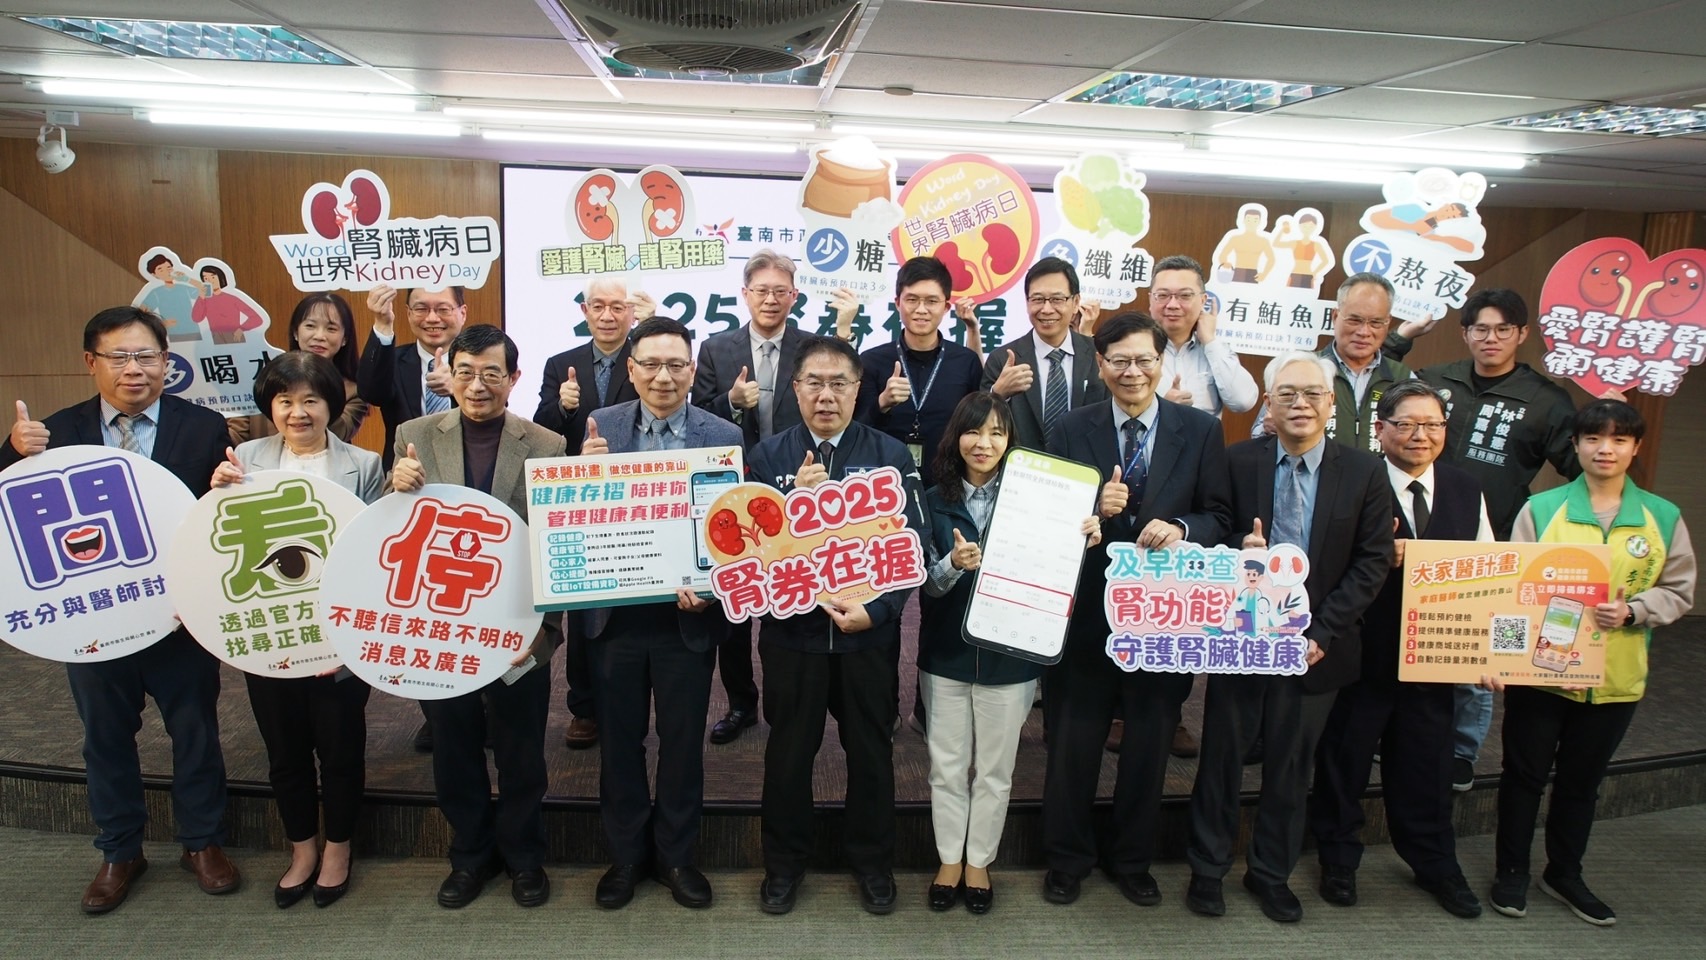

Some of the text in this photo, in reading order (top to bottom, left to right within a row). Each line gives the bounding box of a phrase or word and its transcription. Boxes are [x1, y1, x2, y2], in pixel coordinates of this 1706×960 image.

[925, 190, 1019, 243] 腎臟病日
[284, 241, 347, 258] Word
[348, 225, 492, 261] 腎臟病日
[737, 225, 805, 243] 臺南市
[296, 255, 355, 283] 世界
[355, 261, 481, 284] Kidney Day
[541, 243, 627, 276] 愛護腎臟
[531, 463, 602, 481] 大家醫計畫
[531, 482, 625, 506] 健康存摺
[630, 481, 687, 499] 陪伴你
[788, 474, 898, 534] 2025
[547, 502, 689, 528] 管理健康真便利
[383, 501, 508, 612] 停
[457, 550, 471, 558] STOP
[1412, 552, 1517, 584] 大家醫計畫
[716, 536, 919, 617] 腎券在握
[4, 574, 167, 633] 充分與醫師討
[219, 600, 314, 633] 透過官方
[1112, 587, 1223, 625] 腎功能
[225, 623, 323, 658] 找尋正確
[328, 605, 524, 652] 不聽信來路不明的
[359, 640, 481, 675] 消息及廣告
[1112, 634, 1303, 669] 守護腎臟健康
